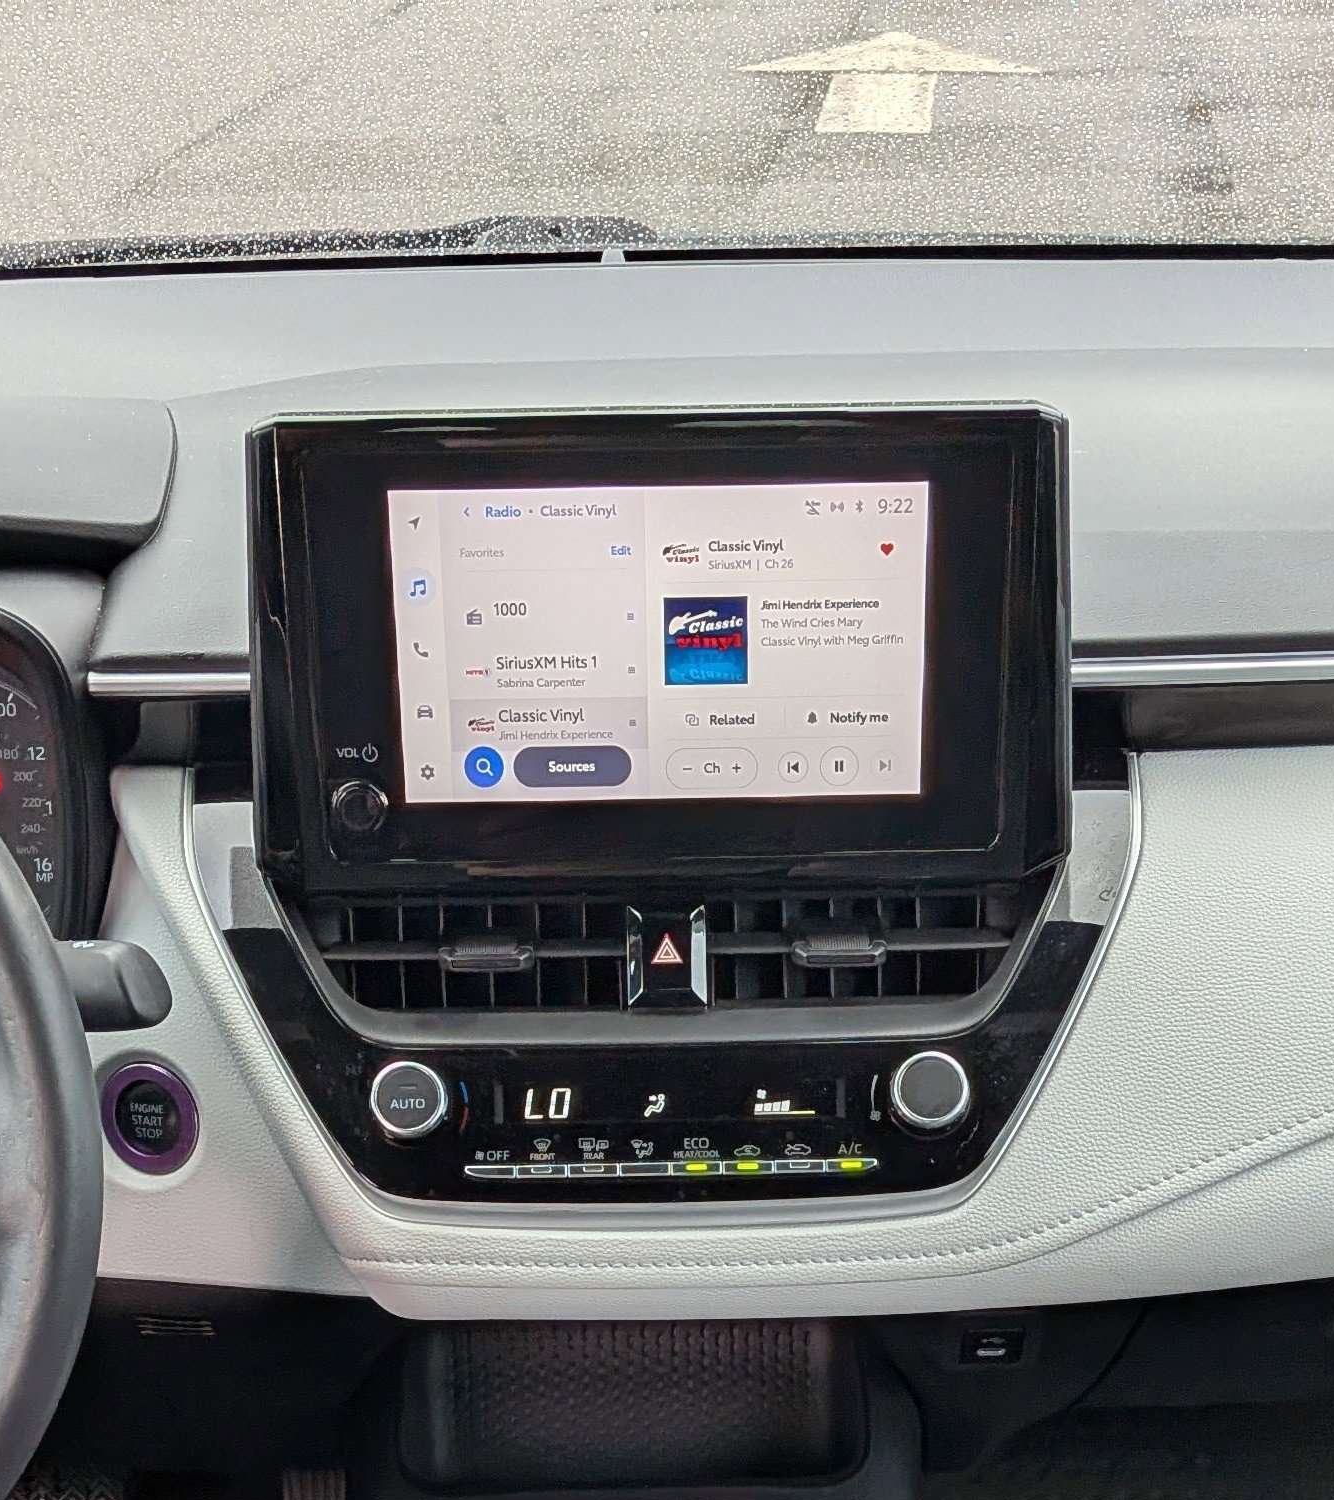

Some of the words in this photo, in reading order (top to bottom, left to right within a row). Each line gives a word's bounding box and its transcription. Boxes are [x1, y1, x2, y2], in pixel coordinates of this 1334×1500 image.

[485, 506, 522, 518] Radio
[540, 505, 583, 517] Classic
[585, 504, 617, 519] Vinyl
[877, 498, 913, 515] 9:22
[611, 546, 632, 556] Edit
[708, 540, 750, 552] Classic
[753, 538, 784, 554] Vinyl
[459, 548, 505, 558] Favorites
[708, 560, 751, 570] SiriusXM
[765, 559, 779, 569] Ch
[780, 558, 793, 569] 26
[493, 602, 527, 616] 1000
[761, 600, 781, 611] Jimi
[783, 600, 822, 609] Hendrix
[824, 598, 879, 610] Experience
[688, 615, 744, 634] Classic
[761, 618, 778, 628] The
[781, 618, 807, 628] Wind
[810, 618, 835, 627] Cries
[837, 618, 863, 630] Mary
[675, 633, 744, 652] vinyl
[761, 637, 795, 647] Classic
[798, 636, 821, 648] Vinyl
[823, 636, 845, 645] with
[847, 636, 869, 648] Meg
[871, 635, 903, 645] Griffin
[496, 656, 557, 670] SiriusXM
[561, 656, 587, 669] Hits
[591, 656, 597, 668] 1
[496, 678, 534, 688] Sabrina
[537, 678, 585, 690] Carpenter
[498, 709, 547, 722] Classic
[550, 708, 585, 724] Vinyl
[709, 714, 755, 726] Related
[830, 712, 867, 725] Notify
[869, 714, 889, 723] me
[499, 730, 518, 741] Jimi
[520, 730, 558, 740] Hendrix
[561, 730, 613, 740] Experience
[27, 746, 45, 760] 12
[336, 748, 359, 758] VOL
[548, 761, 595, 772] Sources
[704, 762, 720, 774] Ch
[13, 771, 33, 782] 200
[22, 797, 42, 808] 220
[21, 824, 41, 834] 240
[33, 857, 52, 872] 16
[35, 872, 54, 883] MP
[129, 1102, 164, 1114] ENGINE
[389, 1098, 425, 1110] AUTO
[524, 1088, 571, 1120] LO
[131, 1114, 163, 1127] START
[134, 1127, 163, 1138] STOP
[683, 1138, 710, 1149] ECO
[837, 1143, 863, 1155] A/C
[487, 1150, 510, 1161] OFF
[529, 1153, 555, 1161] FRONT
[583, 1152, 605, 1160] REAR
[673, 1150, 720, 1158] HEAT/COOL
